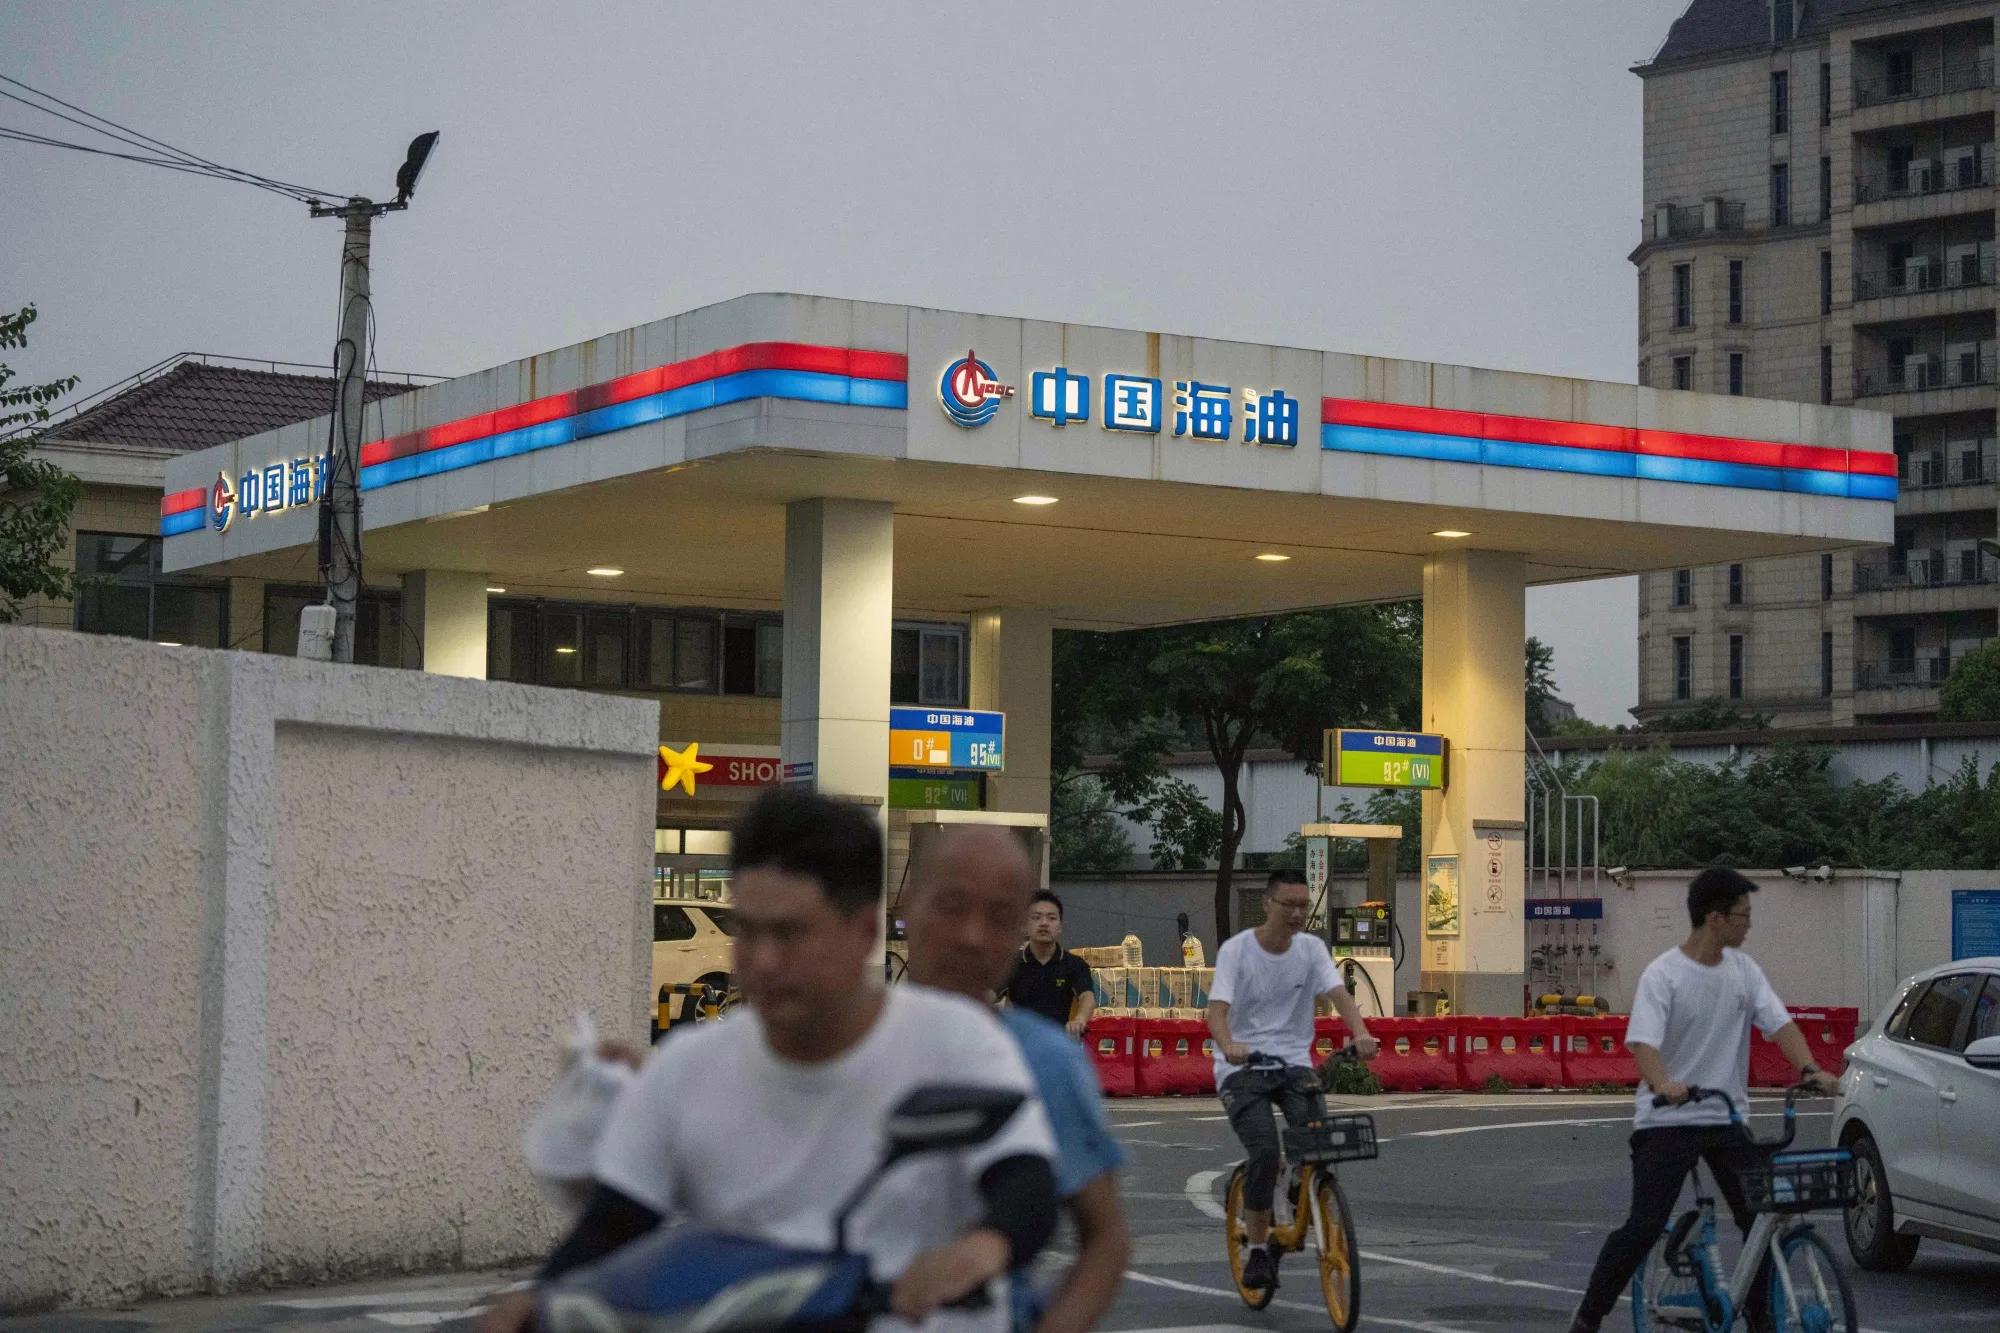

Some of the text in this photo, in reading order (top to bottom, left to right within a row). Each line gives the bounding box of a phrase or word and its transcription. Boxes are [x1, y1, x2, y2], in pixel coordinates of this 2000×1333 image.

[1030, 365, 1299, 448] 中国海油
[927, 713, 975, 726] 中国海油
[1373, 735, 1417, 748] 中国海油
[913, 738, 935, 761] 0#
[1412, 763, 1430, 781] (VI)
[1534, 906, 1571, 916] 中国海油
